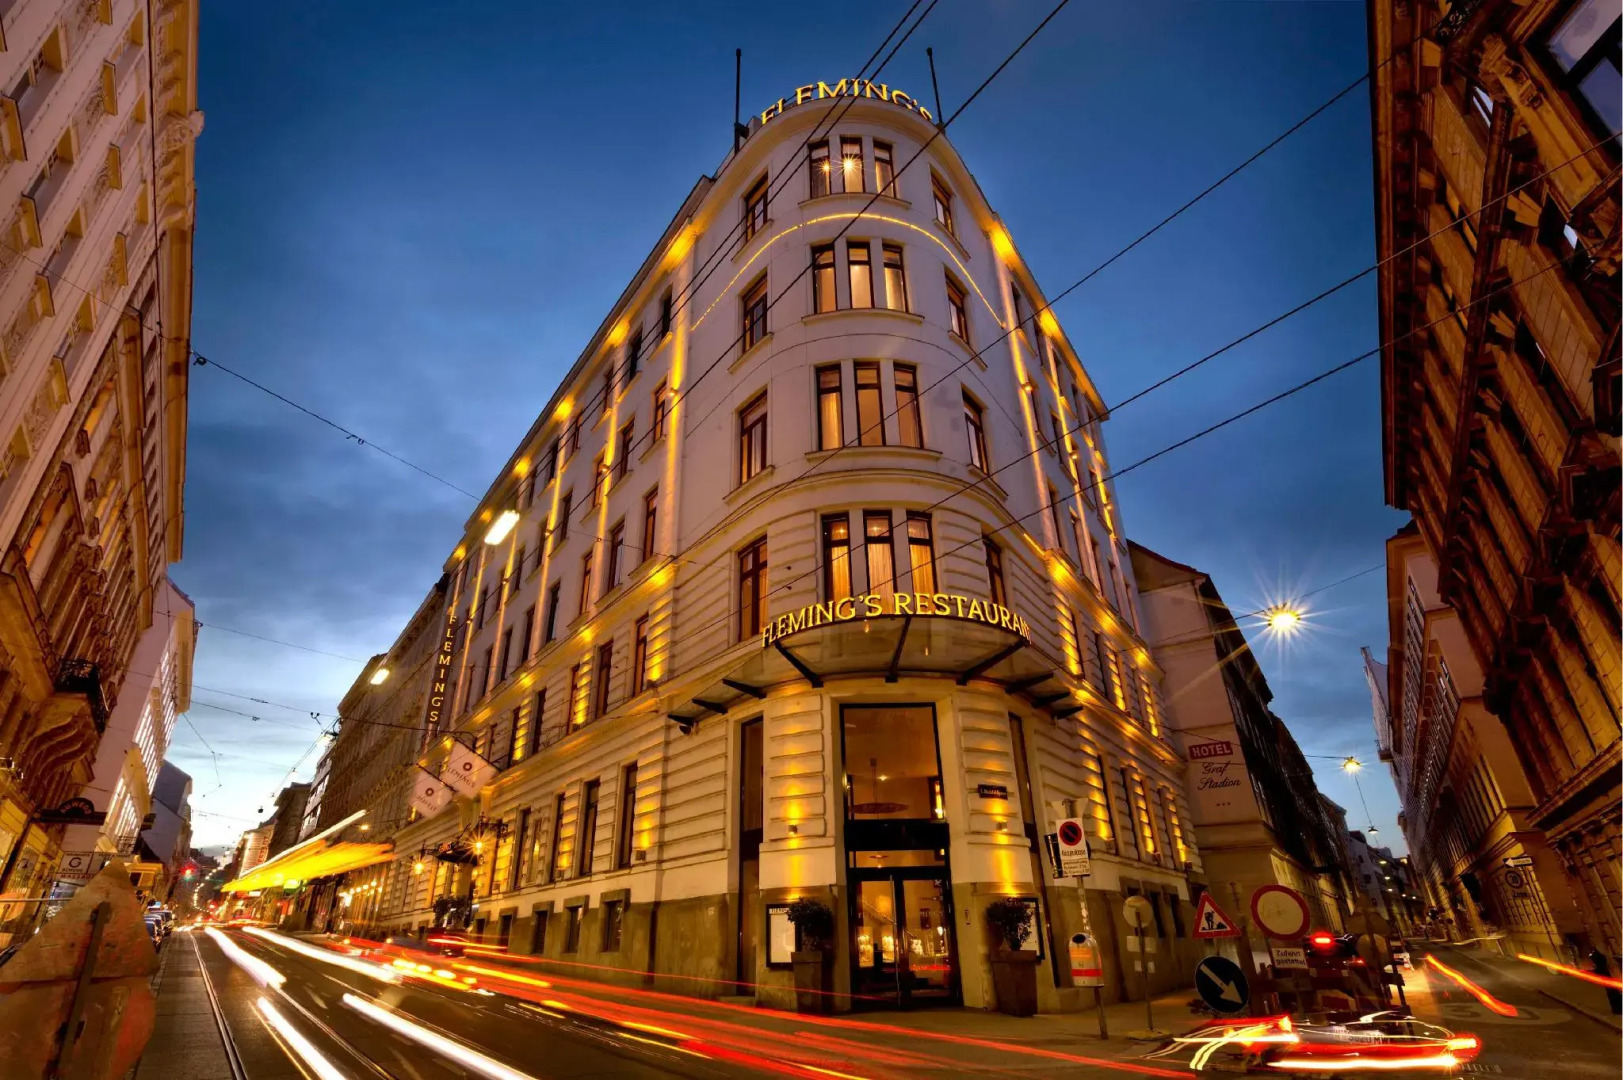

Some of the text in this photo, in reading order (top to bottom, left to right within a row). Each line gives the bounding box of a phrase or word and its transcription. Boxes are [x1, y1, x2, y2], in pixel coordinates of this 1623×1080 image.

[761, 78, 932, 125] FLEMING'S
[762, 594, 883, 648] FLEMING'S
[1191, 744, 1231, 758] HOTEL
[1201, 760, 1231, 777] Graf
[1197, 776, 1241, 790] Stadion
